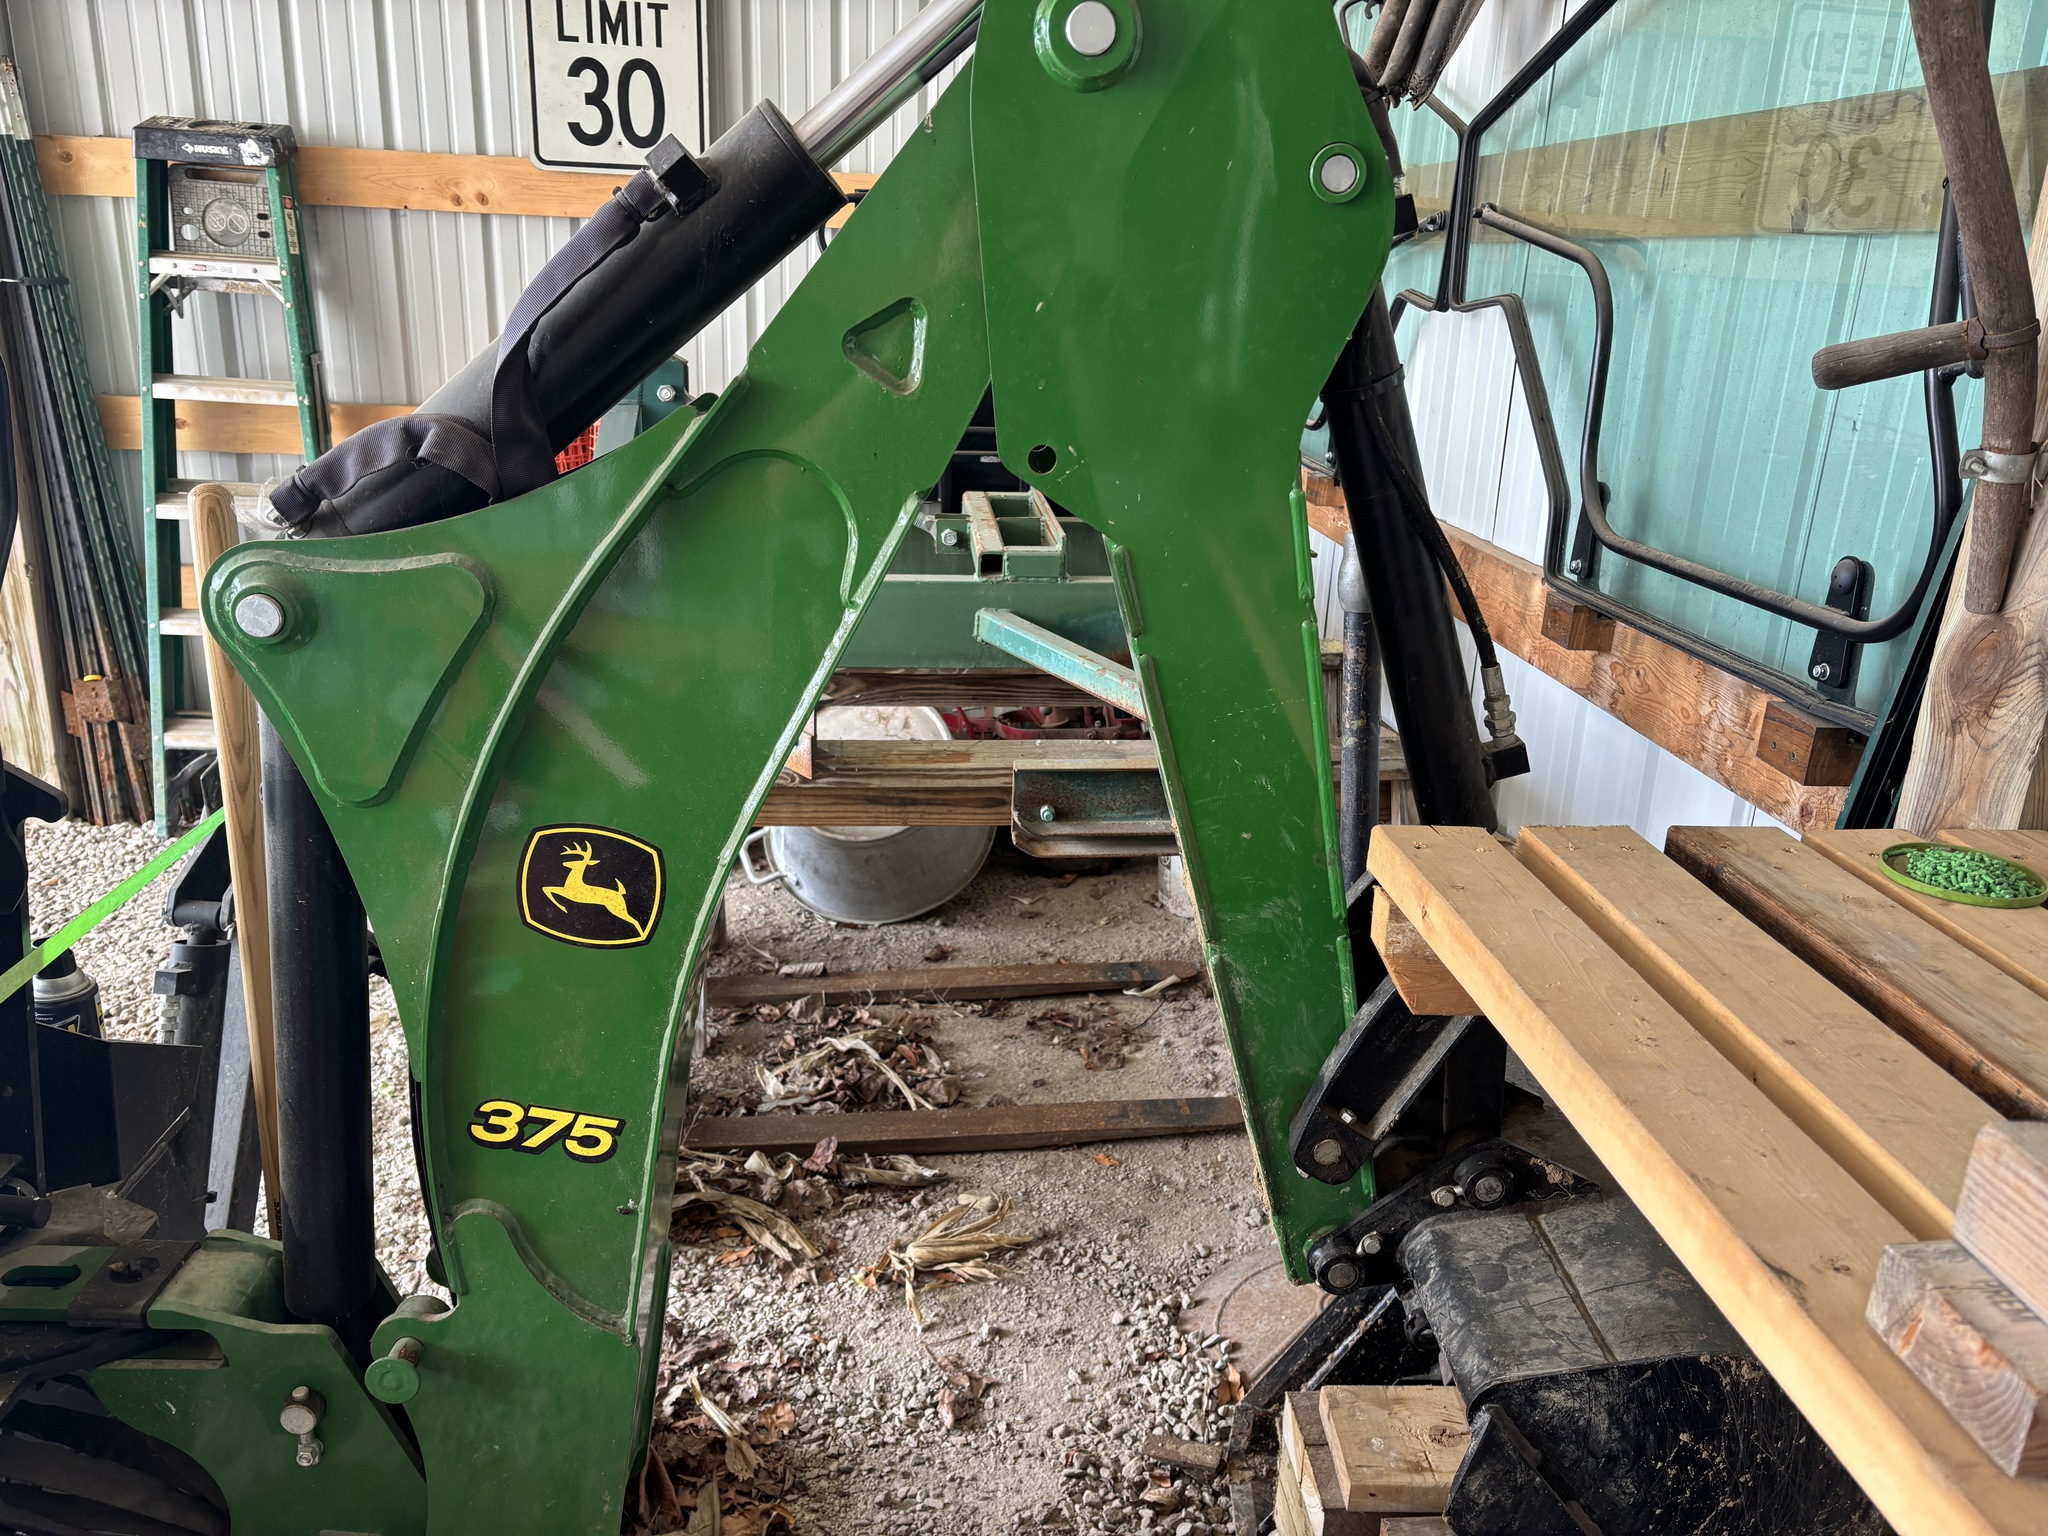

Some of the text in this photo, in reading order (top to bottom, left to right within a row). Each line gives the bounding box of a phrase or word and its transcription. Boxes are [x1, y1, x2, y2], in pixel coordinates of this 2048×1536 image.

[556, 0, 669, 48] LIMIT
[567, 56, 666, 149] 30
[467, 1098, 626, 1164] 375
[274, 1200, 282, 1240] WORKS
